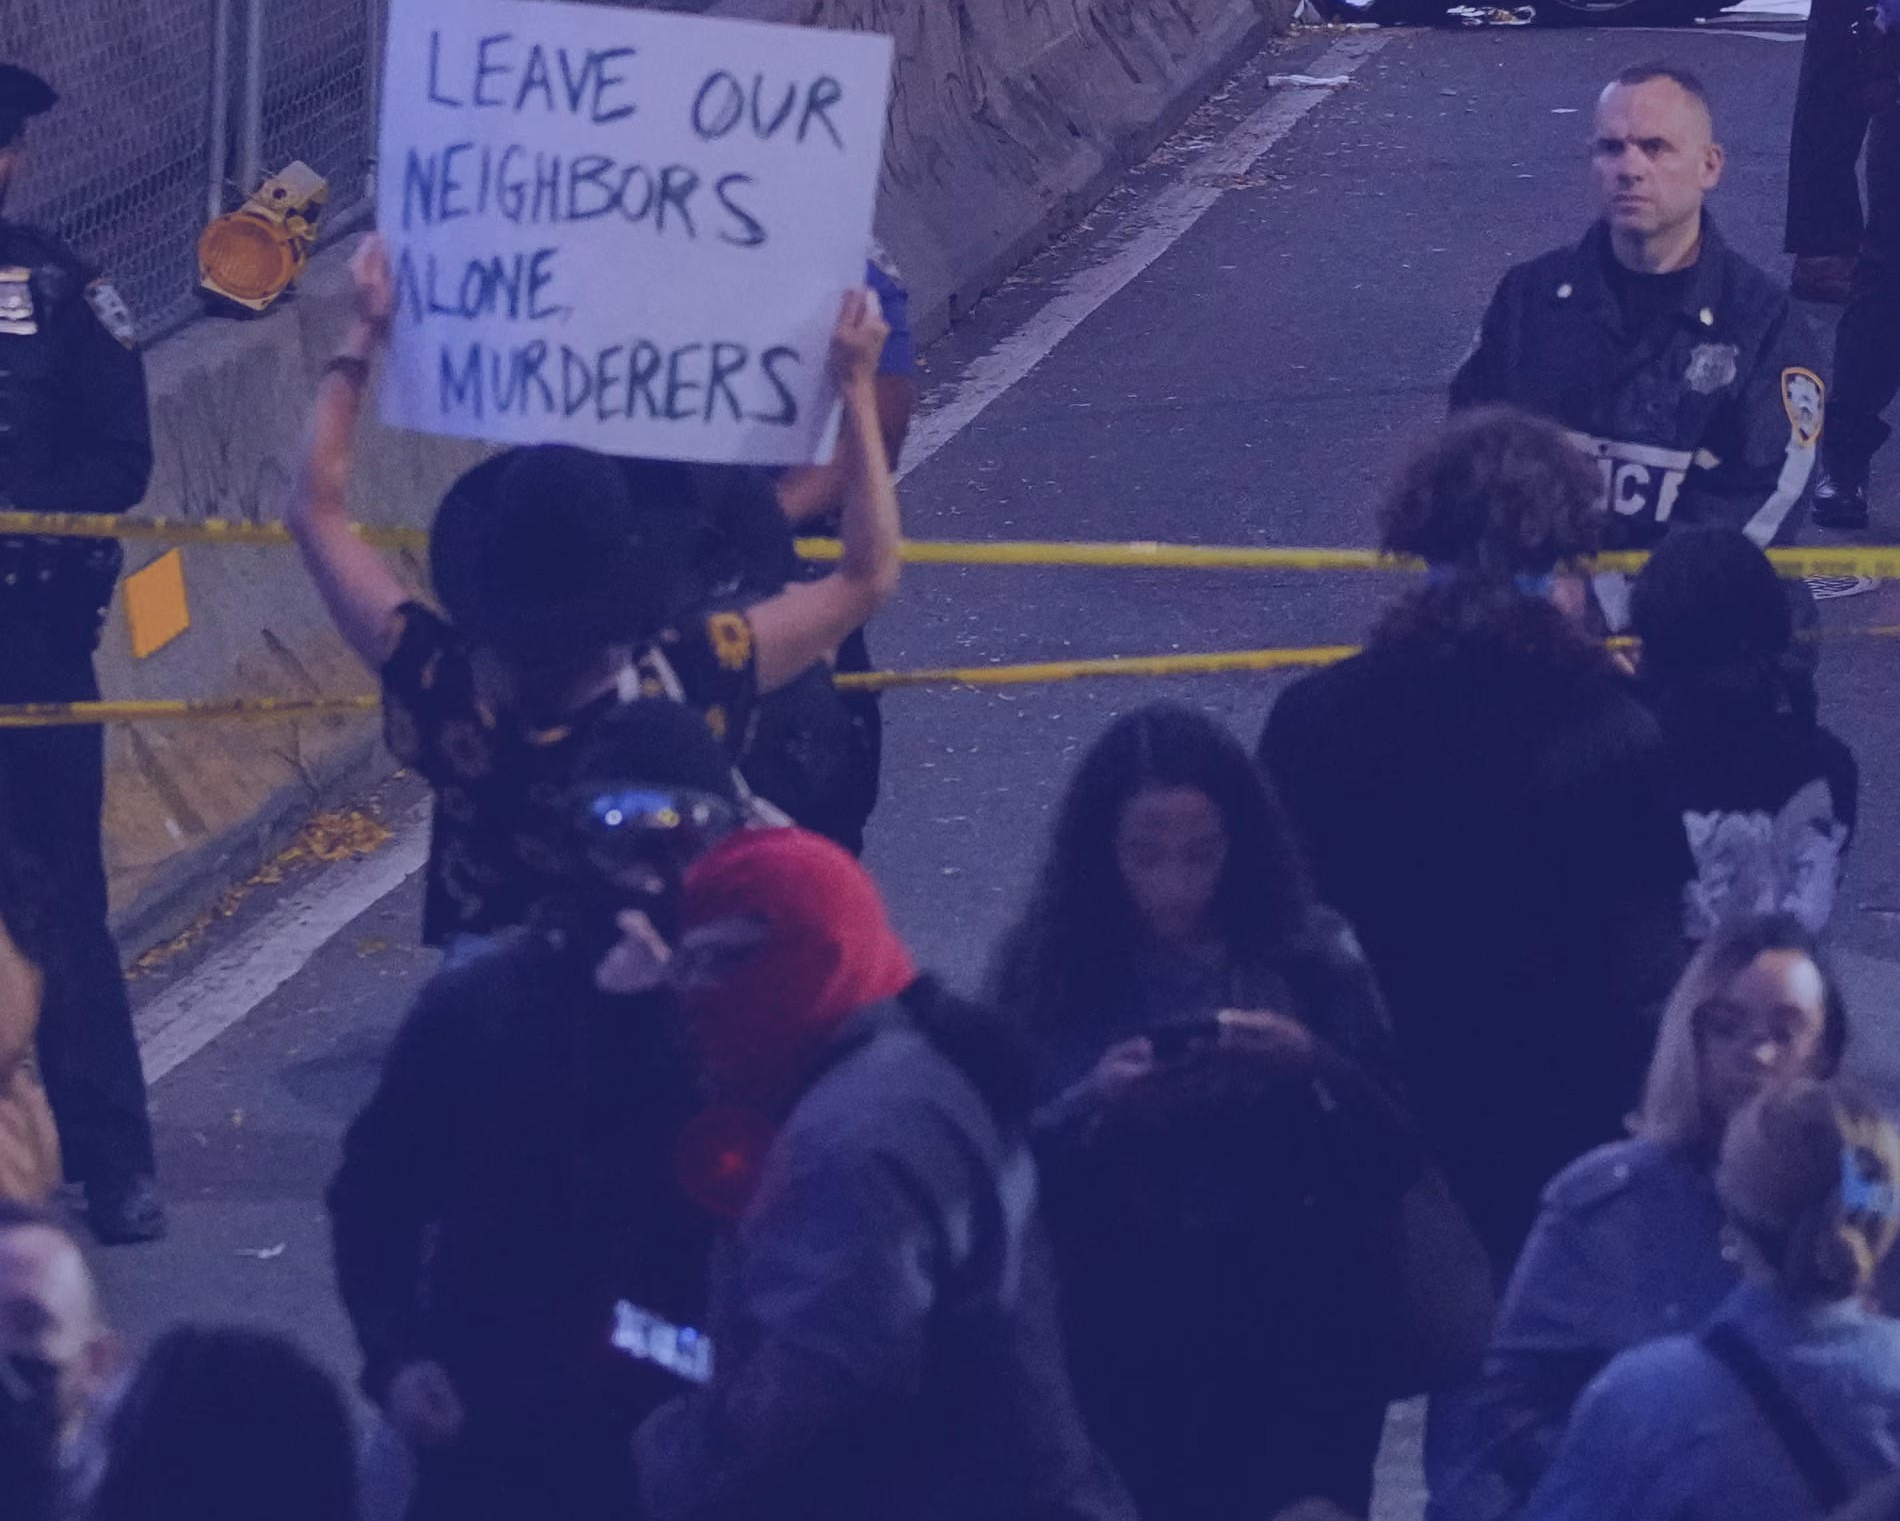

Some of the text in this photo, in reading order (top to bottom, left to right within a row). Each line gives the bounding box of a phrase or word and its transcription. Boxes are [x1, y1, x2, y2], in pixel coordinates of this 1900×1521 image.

[427, 29, 846, 152] LEAVE OUR
[401, 141, 768, 248] NEIGHBORS
[438, 339, 801, 429] MURDERERS
